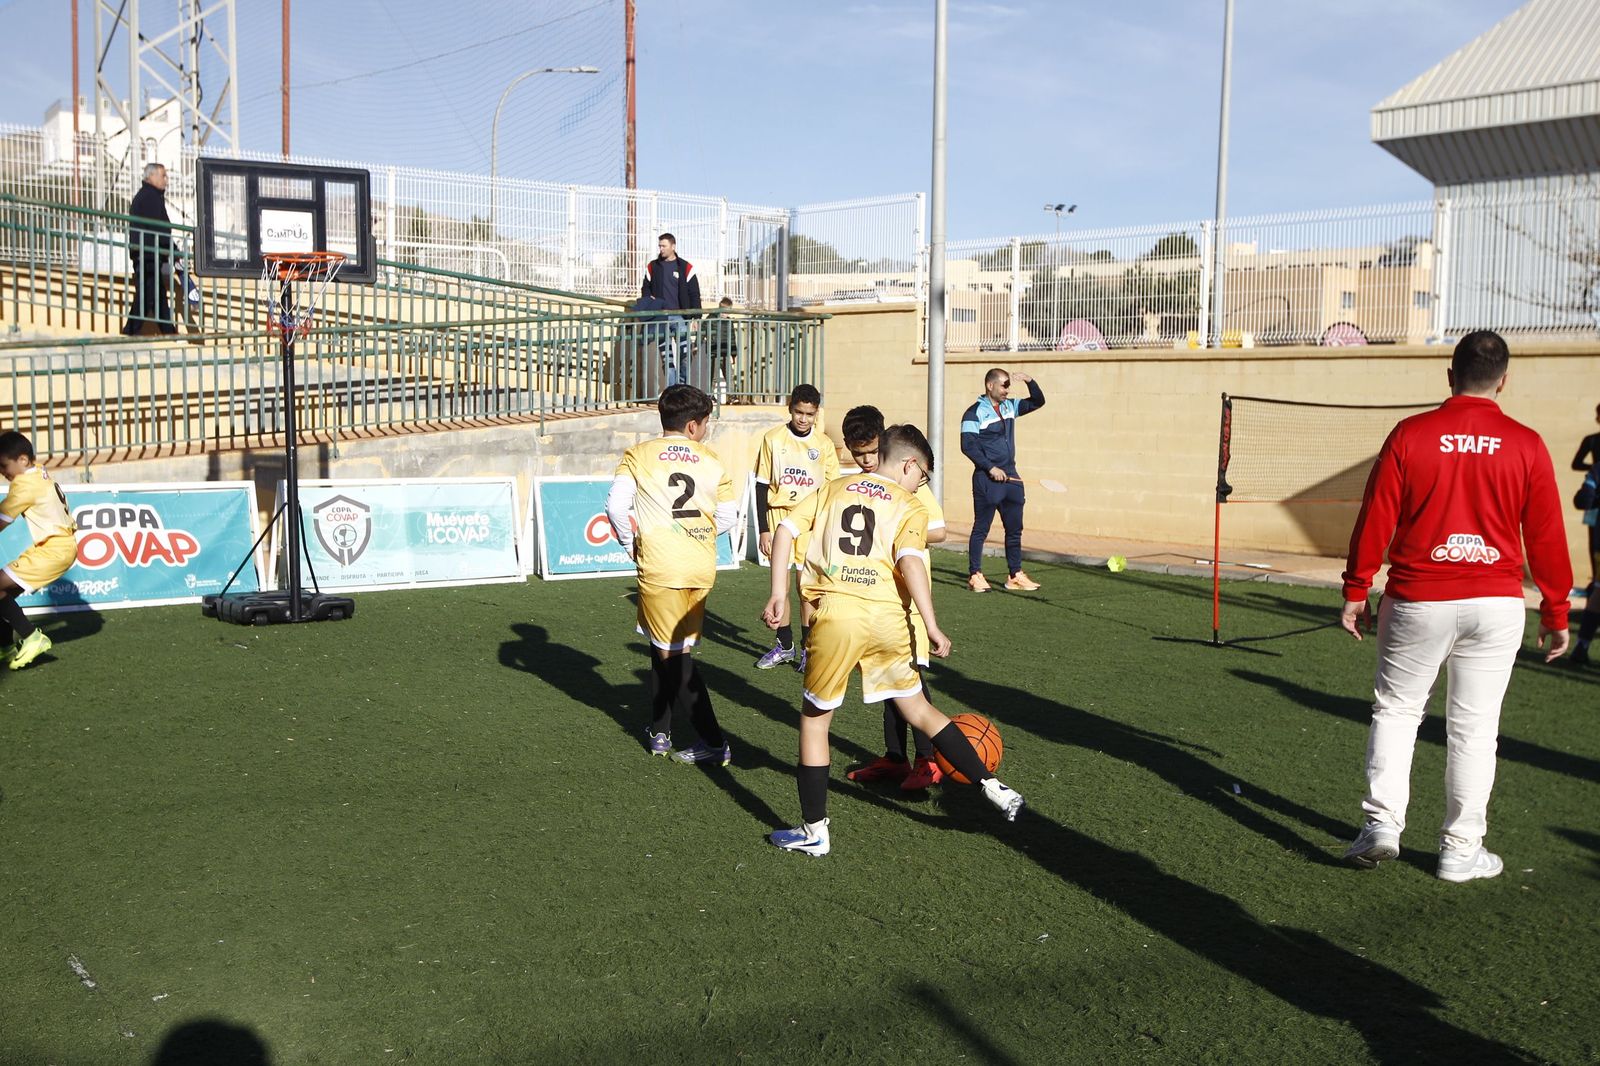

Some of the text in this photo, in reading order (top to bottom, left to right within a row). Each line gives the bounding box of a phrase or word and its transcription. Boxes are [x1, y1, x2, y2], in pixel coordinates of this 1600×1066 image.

[667, 445, 691, 454] COPA
[1439, 434, 1502, 456] STAFF
[658, 451, 700, 465] COVAP
[784, 467, 807, 477] COPA
[846, 483, 893, 501] COVAP
[860, 480, 885, 493] COPA
[667, 472, 702, 519] 2
[788, 490, 798, 502] 2
[326, 512, 359, 522] COVAP
[331, 506, 353, 514] COPA
[76, 507, 160, 530] COPA
[426, 511, 490, 528] Muévete
[838, 504, 876, 558] 9
[1448, 535, 1483, 546] COPA
[75, 531, 198, 568] OVAP
[1431, 545, 1499, 563] COVAP
[840, 574, 876, 587] Unicaja
